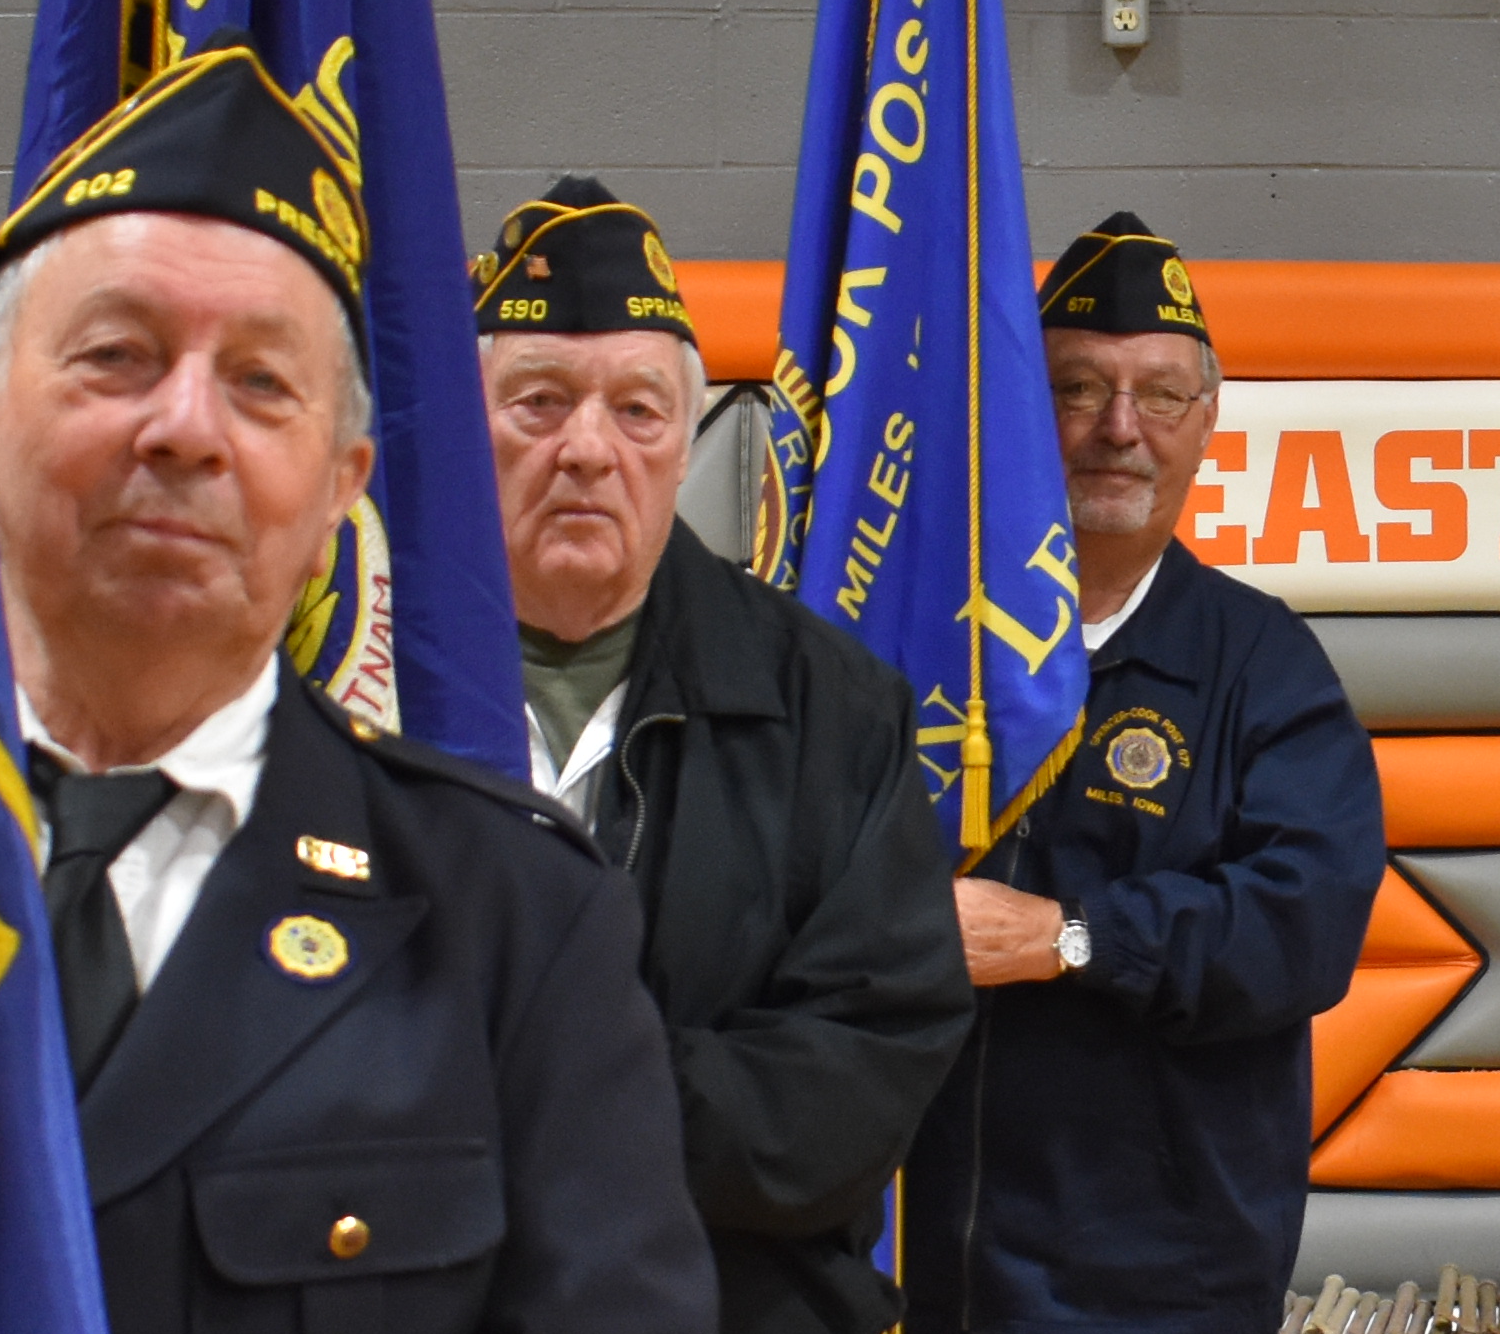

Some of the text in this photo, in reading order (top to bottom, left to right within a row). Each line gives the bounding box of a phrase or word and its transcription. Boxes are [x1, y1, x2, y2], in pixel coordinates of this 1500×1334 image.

[62, 167, 137, 206] 602
[499, 298, 548, 322] 590
[1066, 296, 1098, 314] 677
[1132, 796, 1166, 818] IOWA
